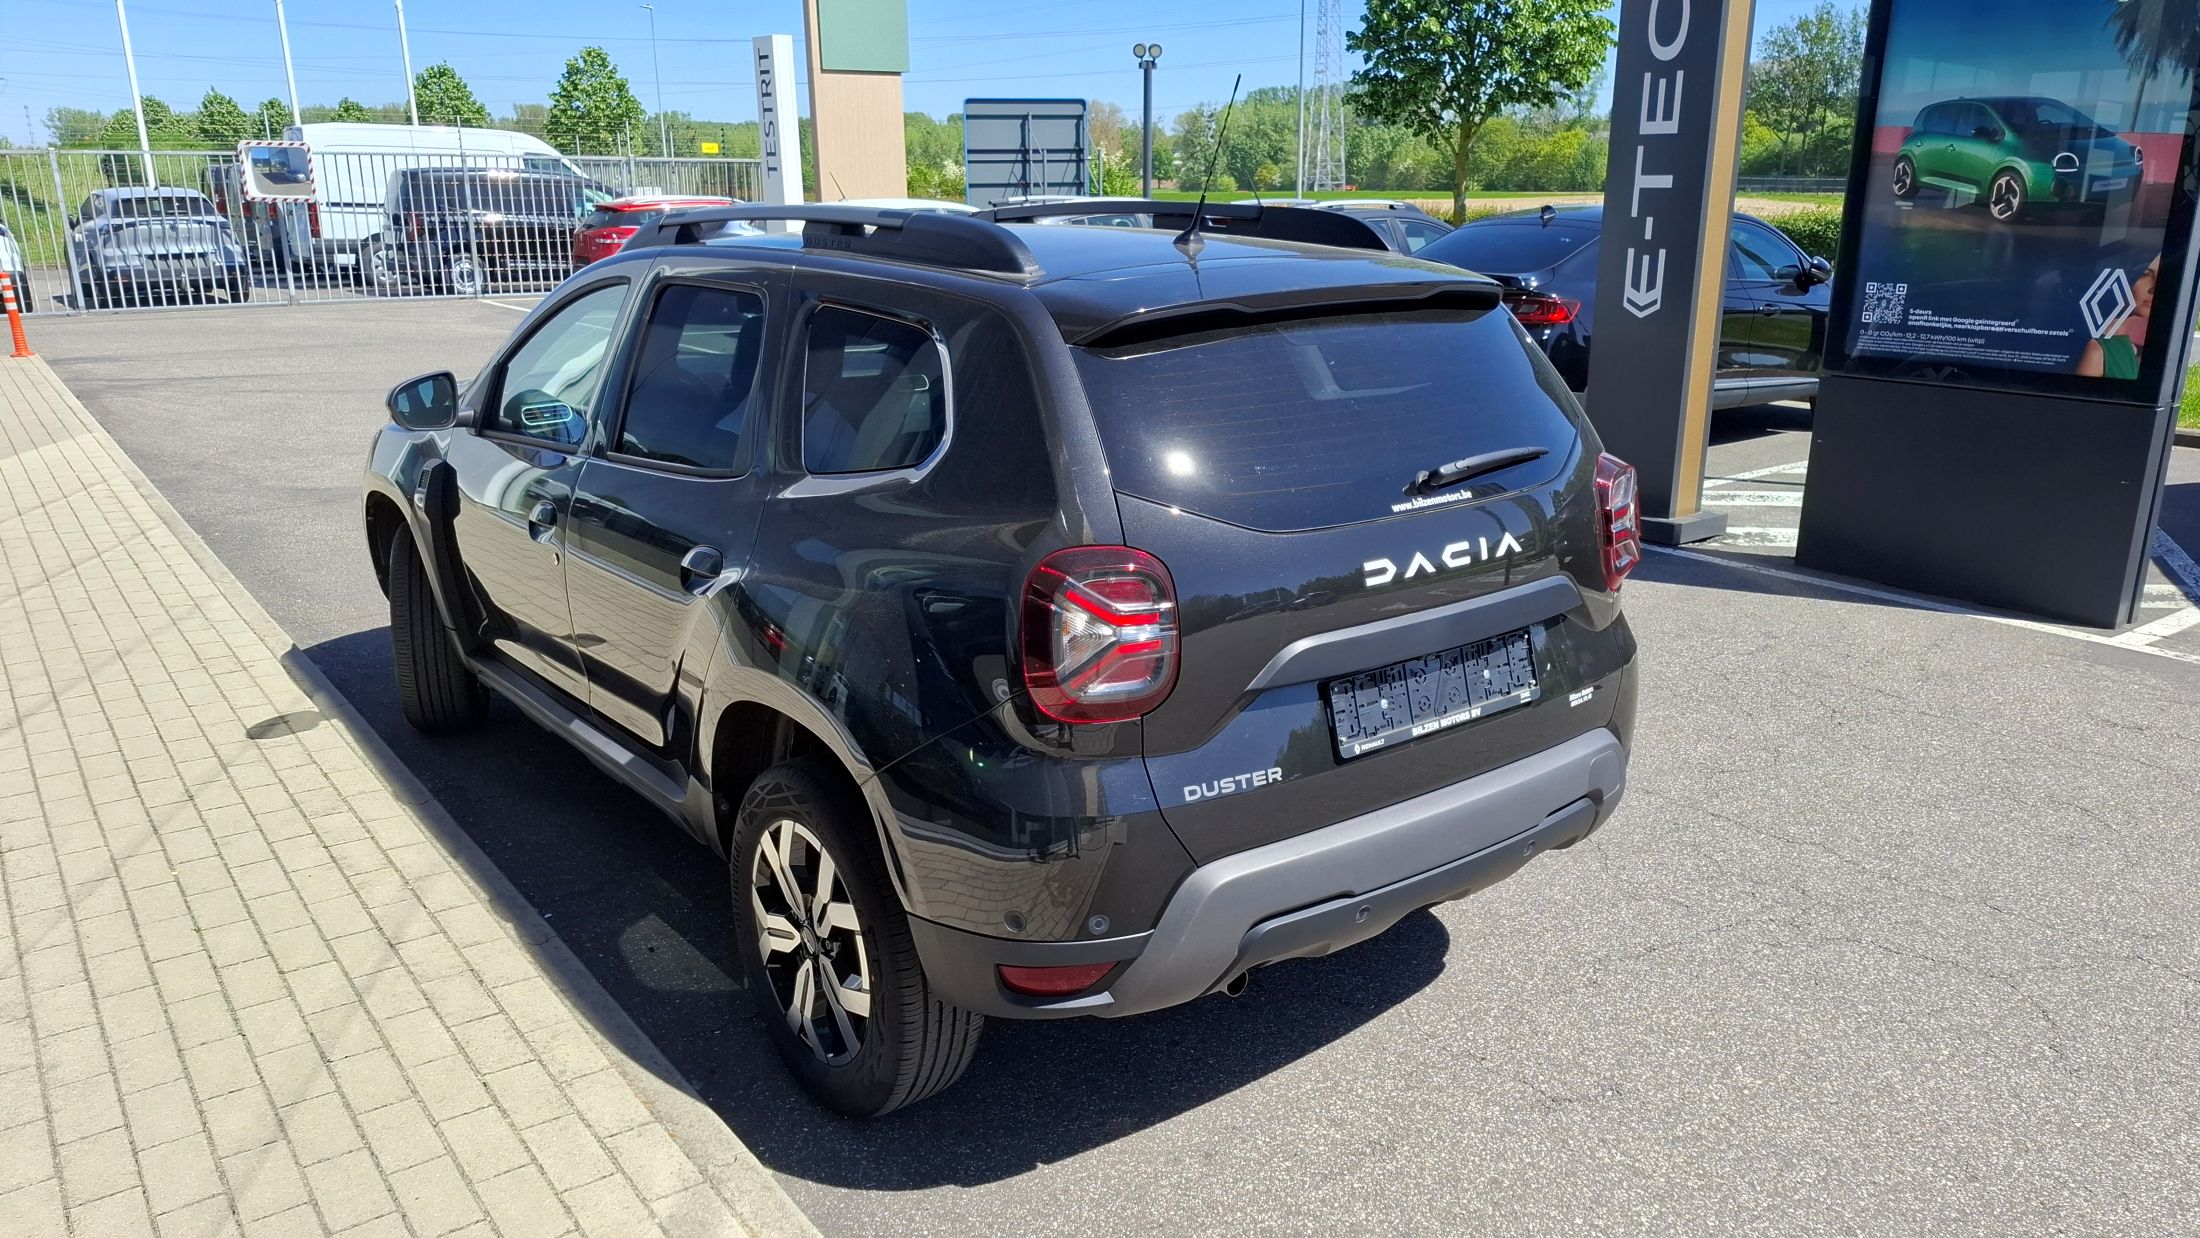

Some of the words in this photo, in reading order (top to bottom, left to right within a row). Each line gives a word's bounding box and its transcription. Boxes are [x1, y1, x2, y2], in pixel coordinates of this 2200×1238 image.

[758, 47, 778, 178] TESTRIT
[1952, 317, 1974, 325] Google
[1953, 323, 1995, 331] neerklapbare
[1391, 489, 1473, 513] www.bilzenmotors.be
[1363, 531, 1523, 587] DACIA
[1361, 738, 1385, 751] RENAULT
[1411, 720, 1440, 737] BILZEN
[1440, 710, 1470, 727] MOTORS
[1183, 767, 1283, 802] DUSTER
